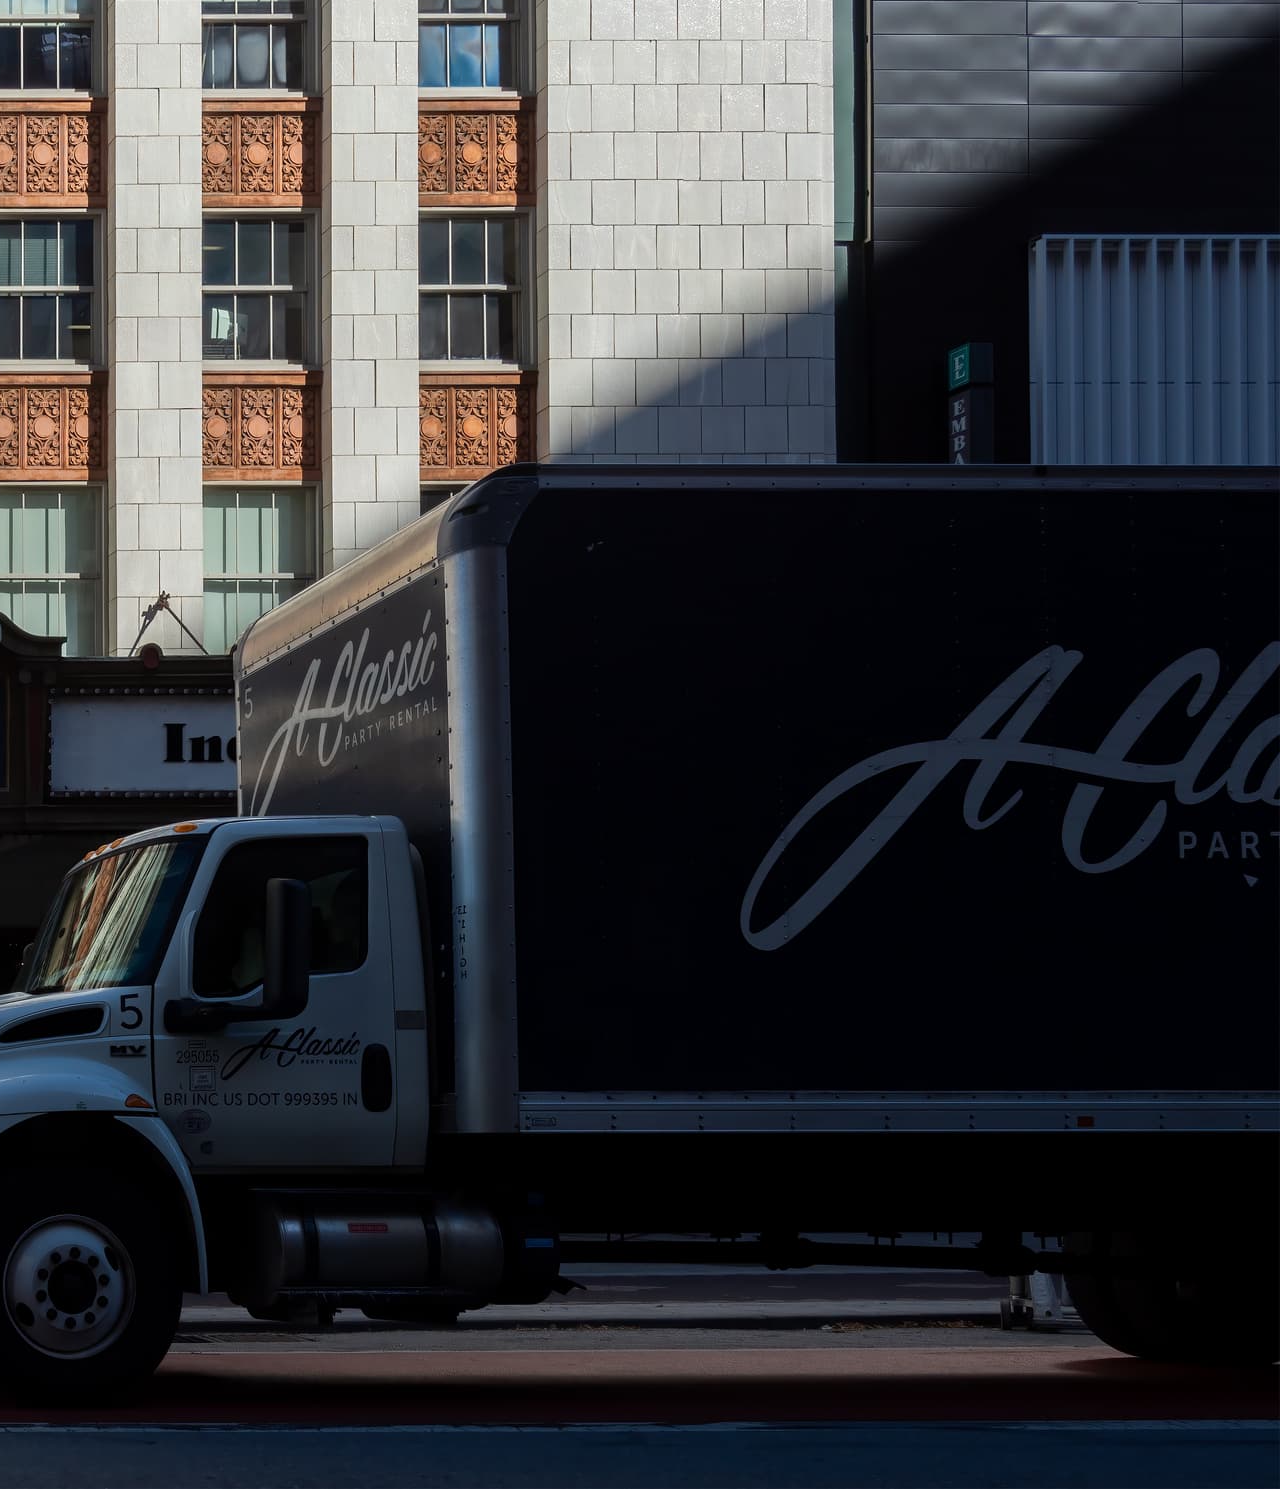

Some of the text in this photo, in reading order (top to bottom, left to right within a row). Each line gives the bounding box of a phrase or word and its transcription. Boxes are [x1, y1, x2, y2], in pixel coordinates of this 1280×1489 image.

[244, 687, 254, 719] 5
[318, 608, 438, 767] Classic
[344, 696, 438, 751] PARTY RENTAL
[740, 646, 1083, 951] A
[119, 994, 144, 1030] 5
[110, 1045, 146, 1054] MV
[176, 1050, 219, 1064] 295055
[278, 1027, 360, 1067] Classic
[164, 1093, 358, 1106] BRI INC US DOT 999395 IN
